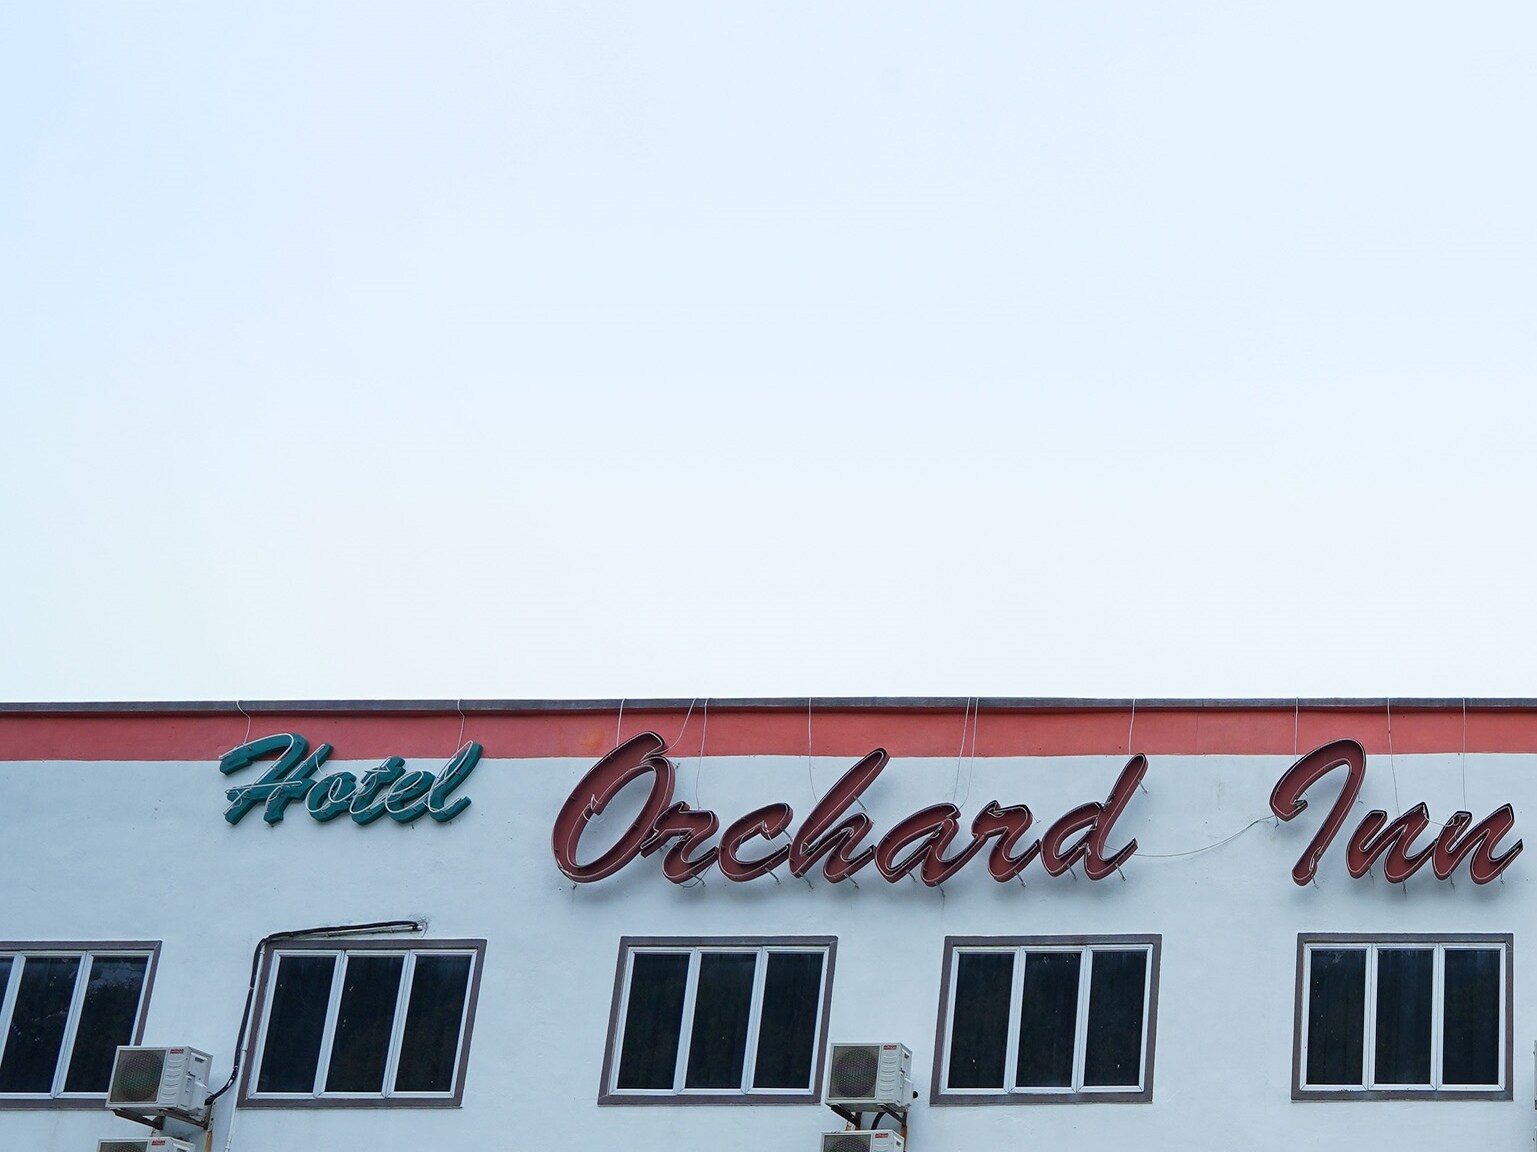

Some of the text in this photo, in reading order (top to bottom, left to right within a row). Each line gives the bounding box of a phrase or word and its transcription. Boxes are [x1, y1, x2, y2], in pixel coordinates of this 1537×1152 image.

[219, 730, 1524, 887] Hotel Orchard Inn
